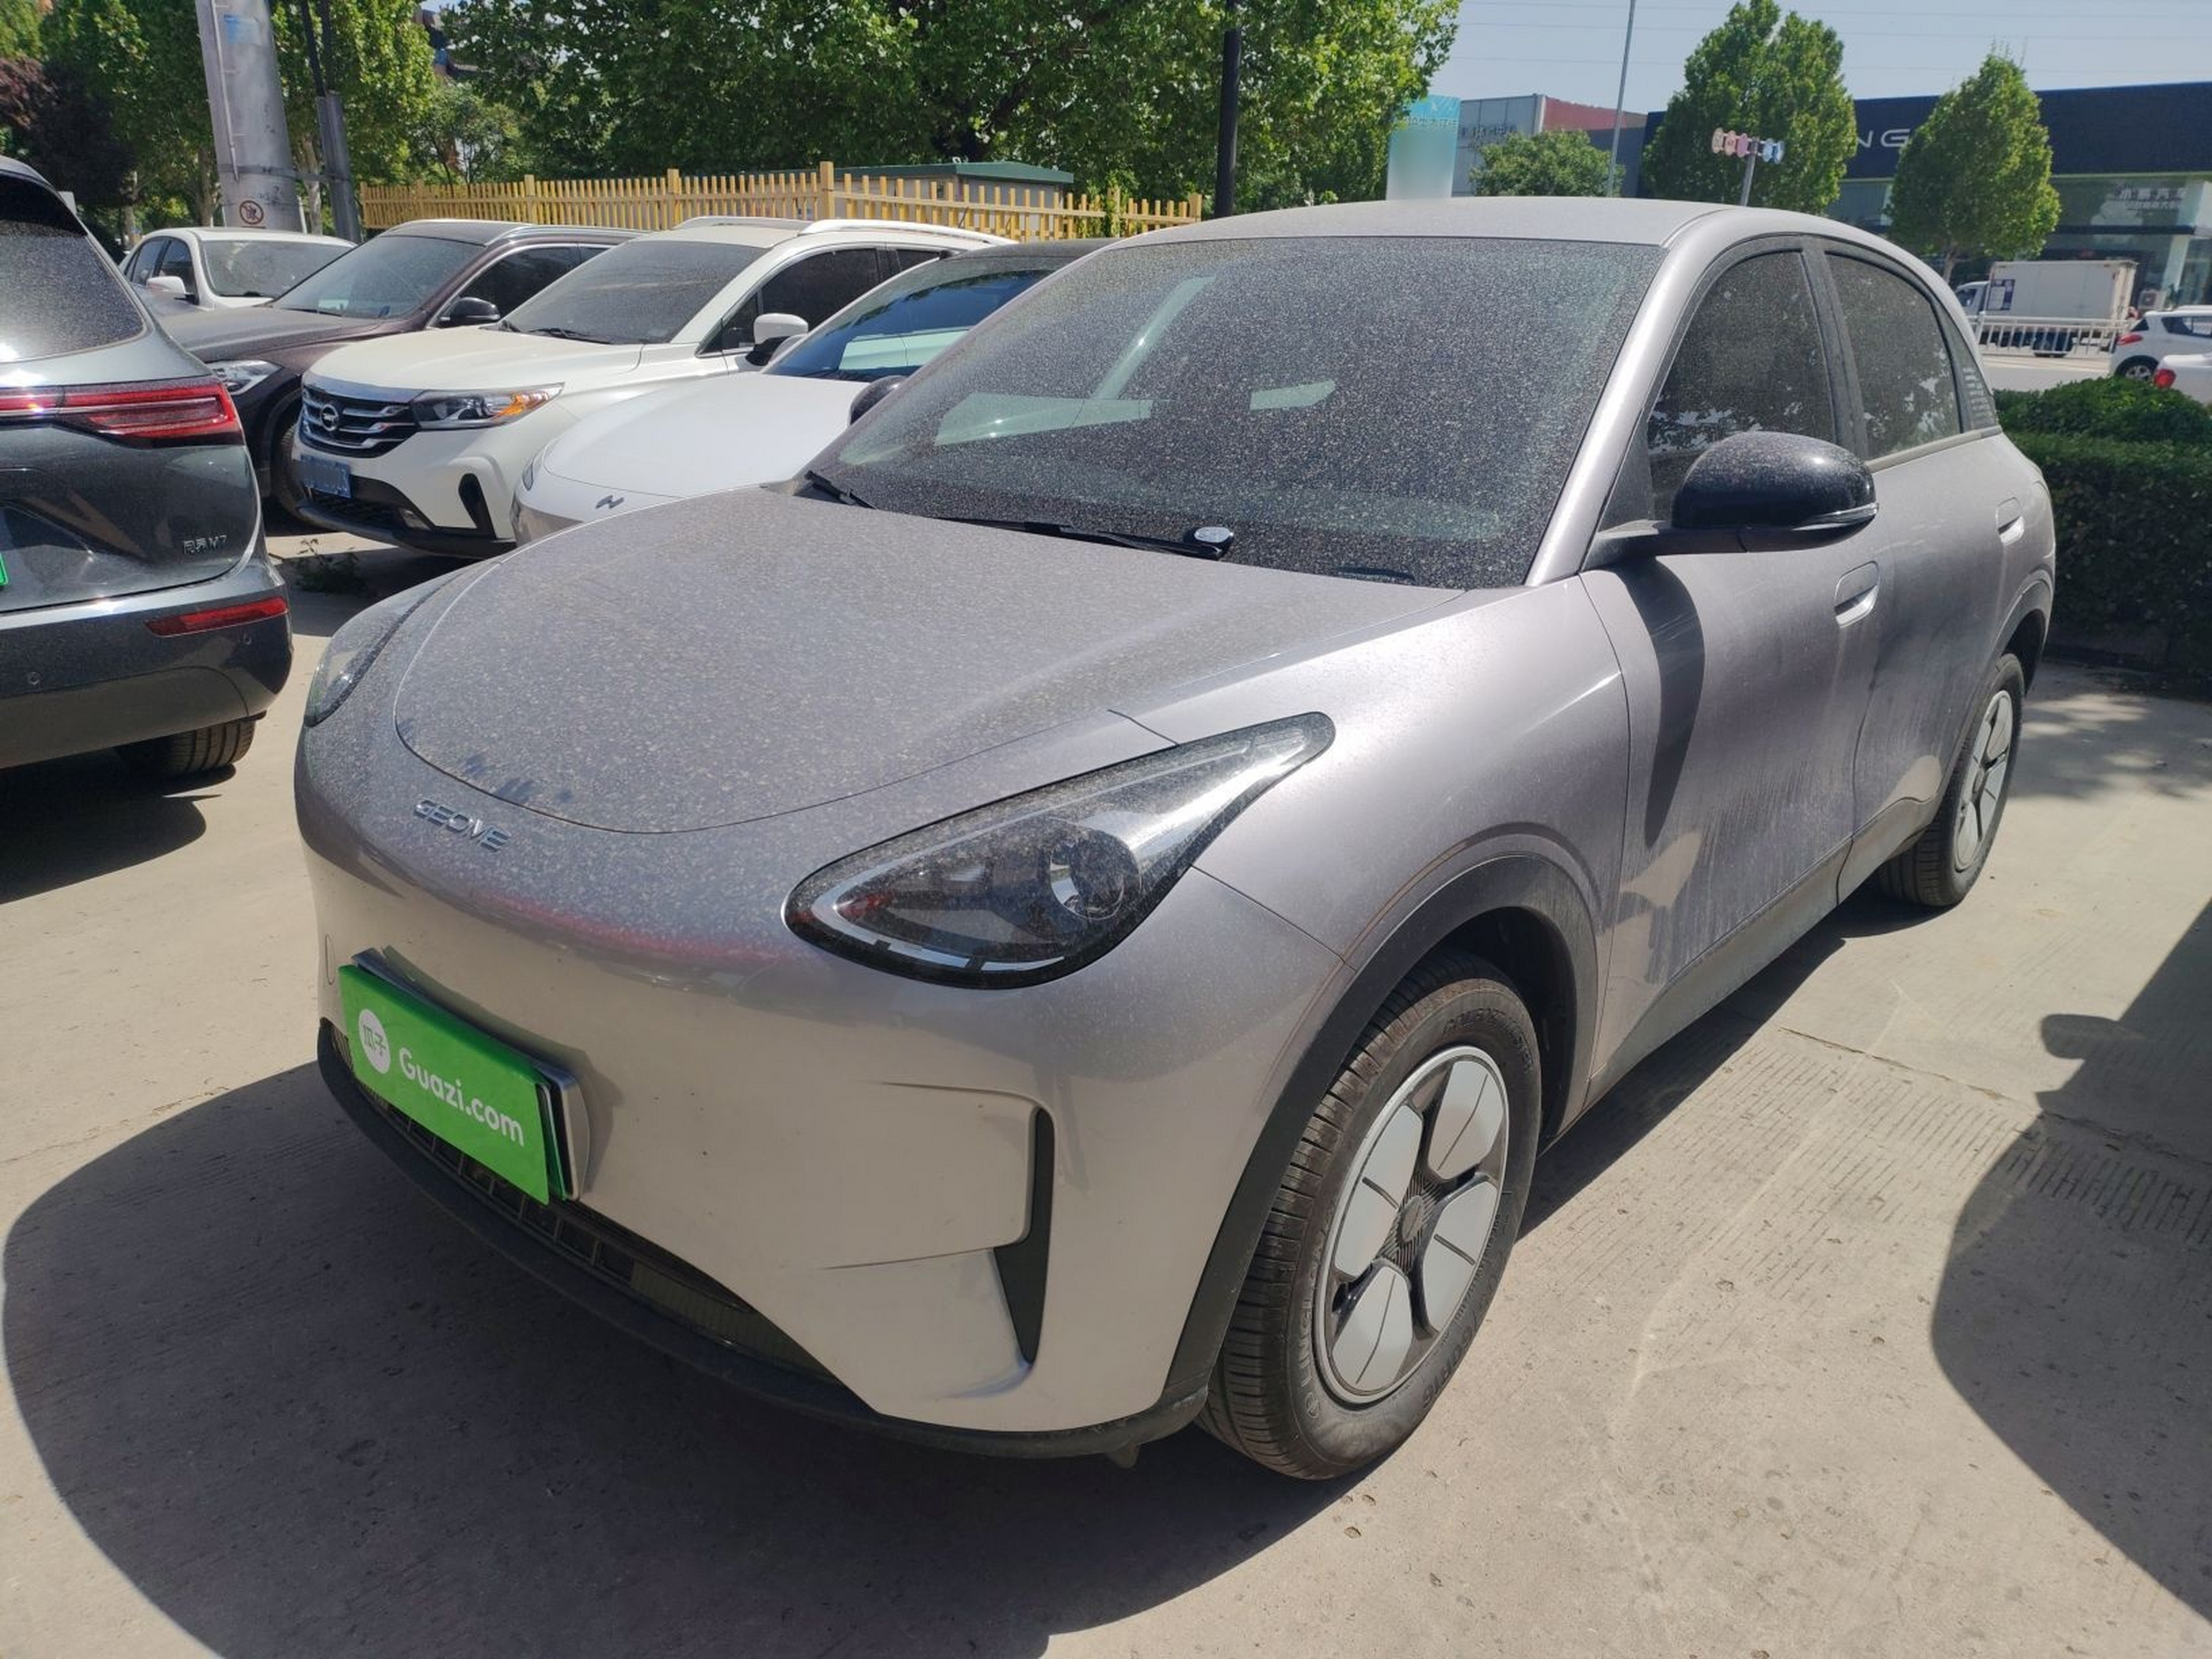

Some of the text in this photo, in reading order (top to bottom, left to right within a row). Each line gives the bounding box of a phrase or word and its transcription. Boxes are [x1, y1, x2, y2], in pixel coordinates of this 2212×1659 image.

[413, 798, 512, 853] GEOME
[363, 1024, 387, 1058] 瓜子
[399, 1047, 524, 1147] Guazi.com
